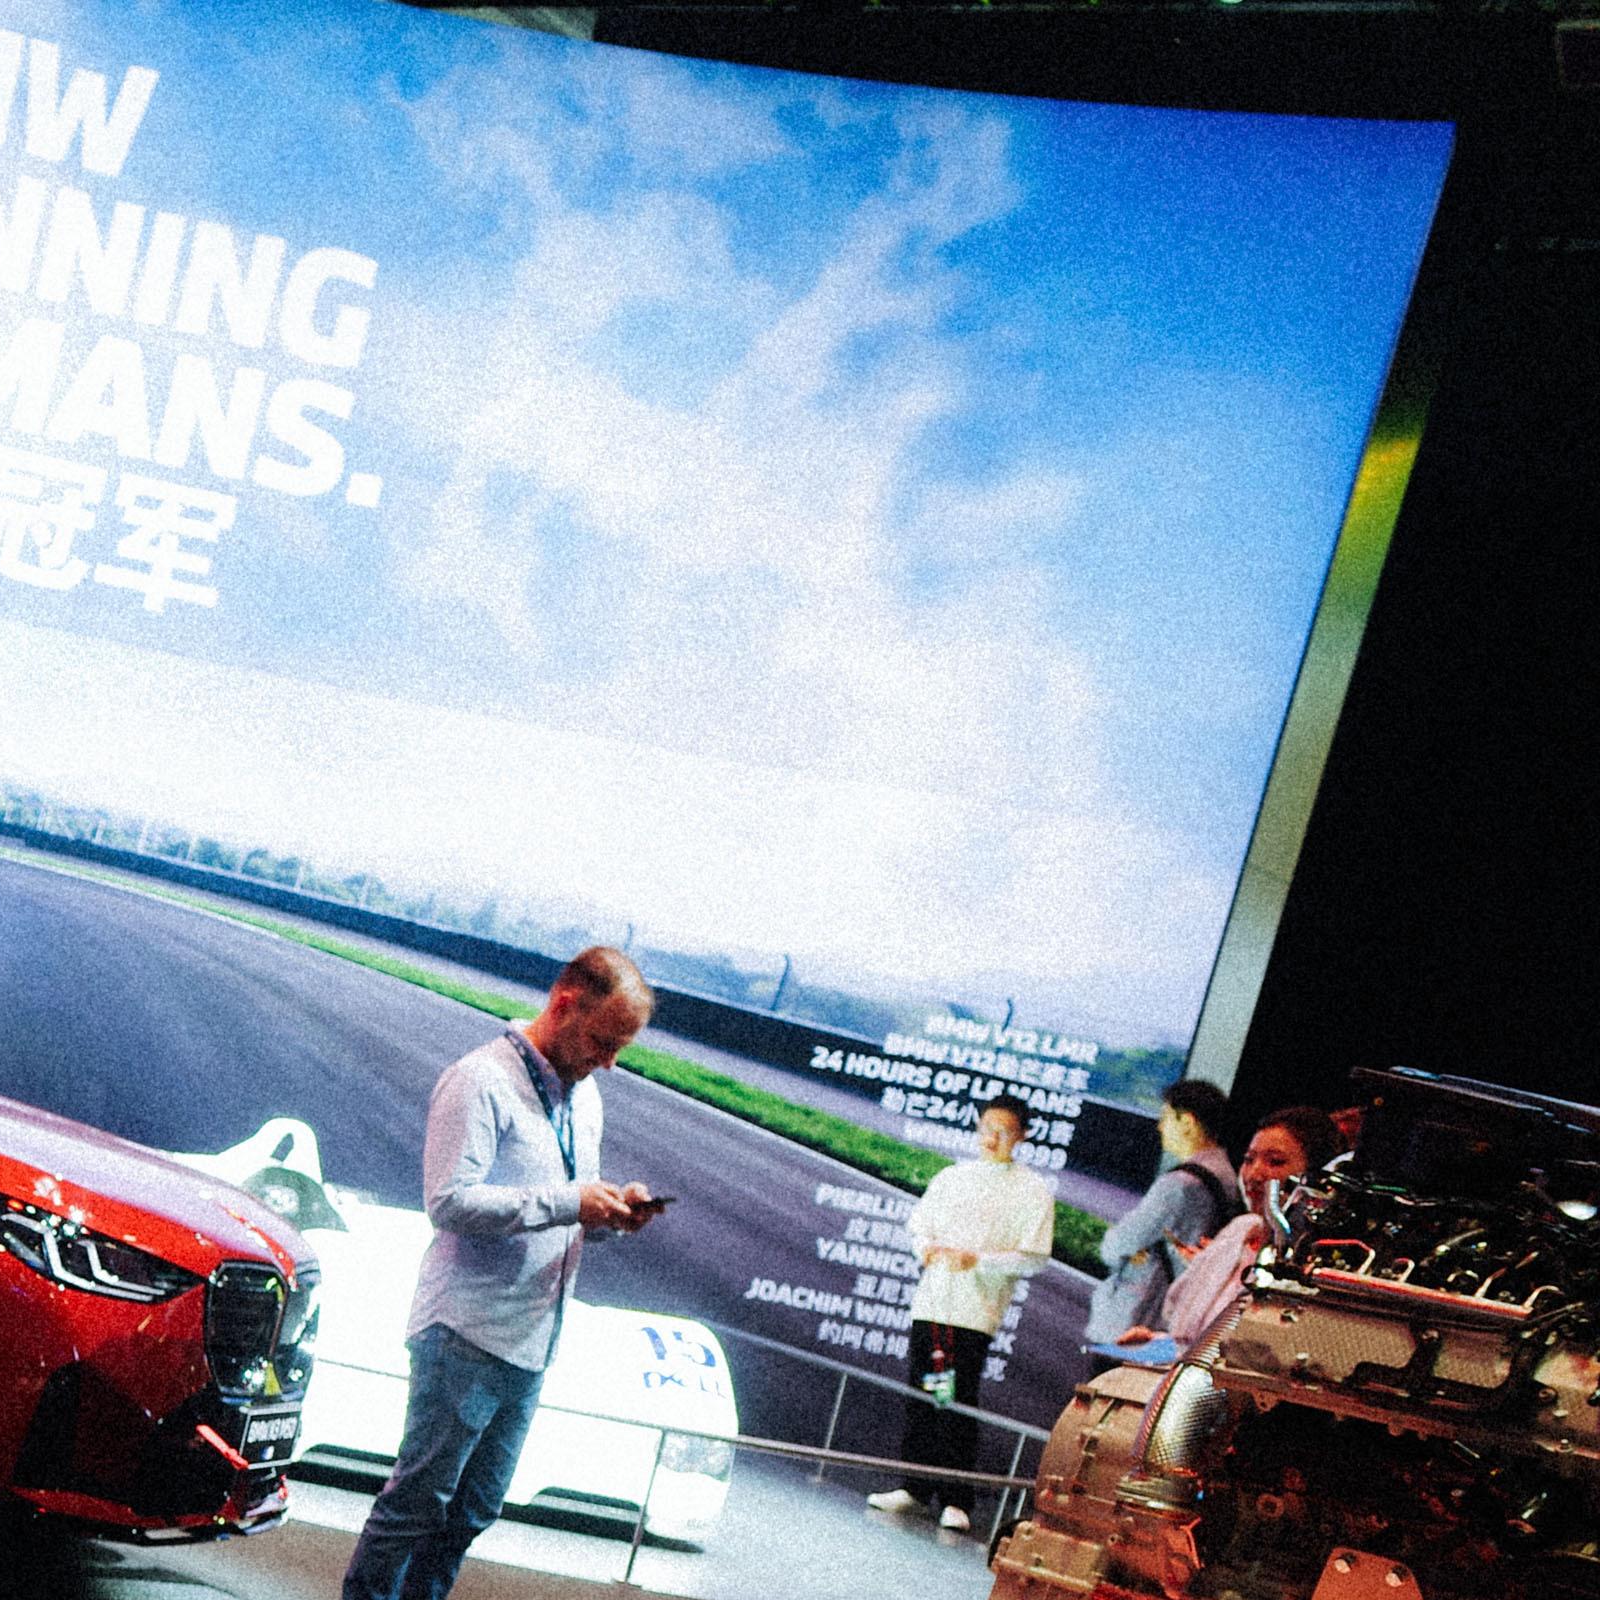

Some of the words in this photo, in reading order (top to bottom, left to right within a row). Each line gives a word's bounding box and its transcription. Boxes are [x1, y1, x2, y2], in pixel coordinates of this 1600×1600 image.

[882, 1031, 949, 1064] BMW
[923, 1015, 991, 1044] BMW
[809, 1045, 845, 1073] 24
[844, 1052, 933, 1089] HOURS
[933, 1069, 972, 1094] OF
[815, 1236, 924, 1280] YANNICK
[743, 1276, 853, 1319] JOACHIM
